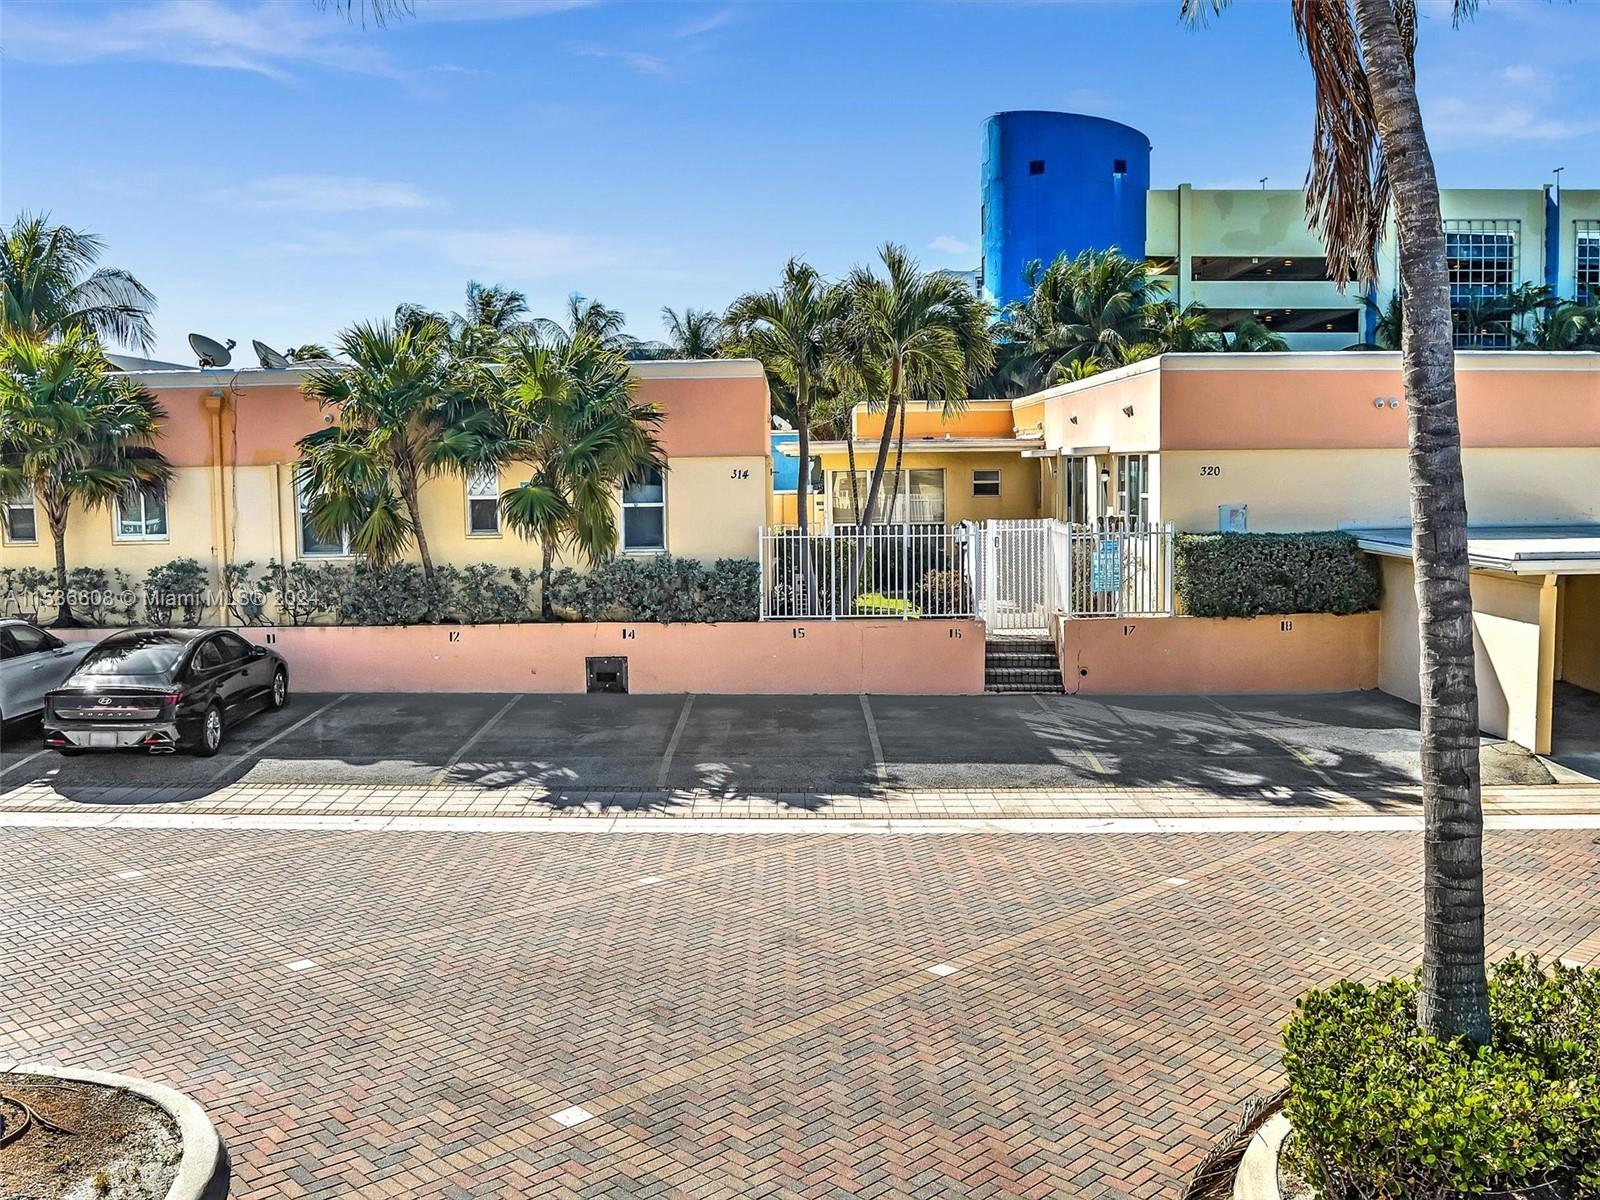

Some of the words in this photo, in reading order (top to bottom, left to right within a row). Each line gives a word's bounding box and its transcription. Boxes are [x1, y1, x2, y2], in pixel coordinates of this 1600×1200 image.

[730, 469, 750, 480] 314
[1199, 465, 1221, 477] 320
[1123, 625, 1136, 636] 17
[1281, 619, 1293, 632] 18
[449, 631, 461, 643] 12
[622, 628, 636, 640] 14
[792, 627, 806, 639] 15
[949, 628, 962, 639] 16
